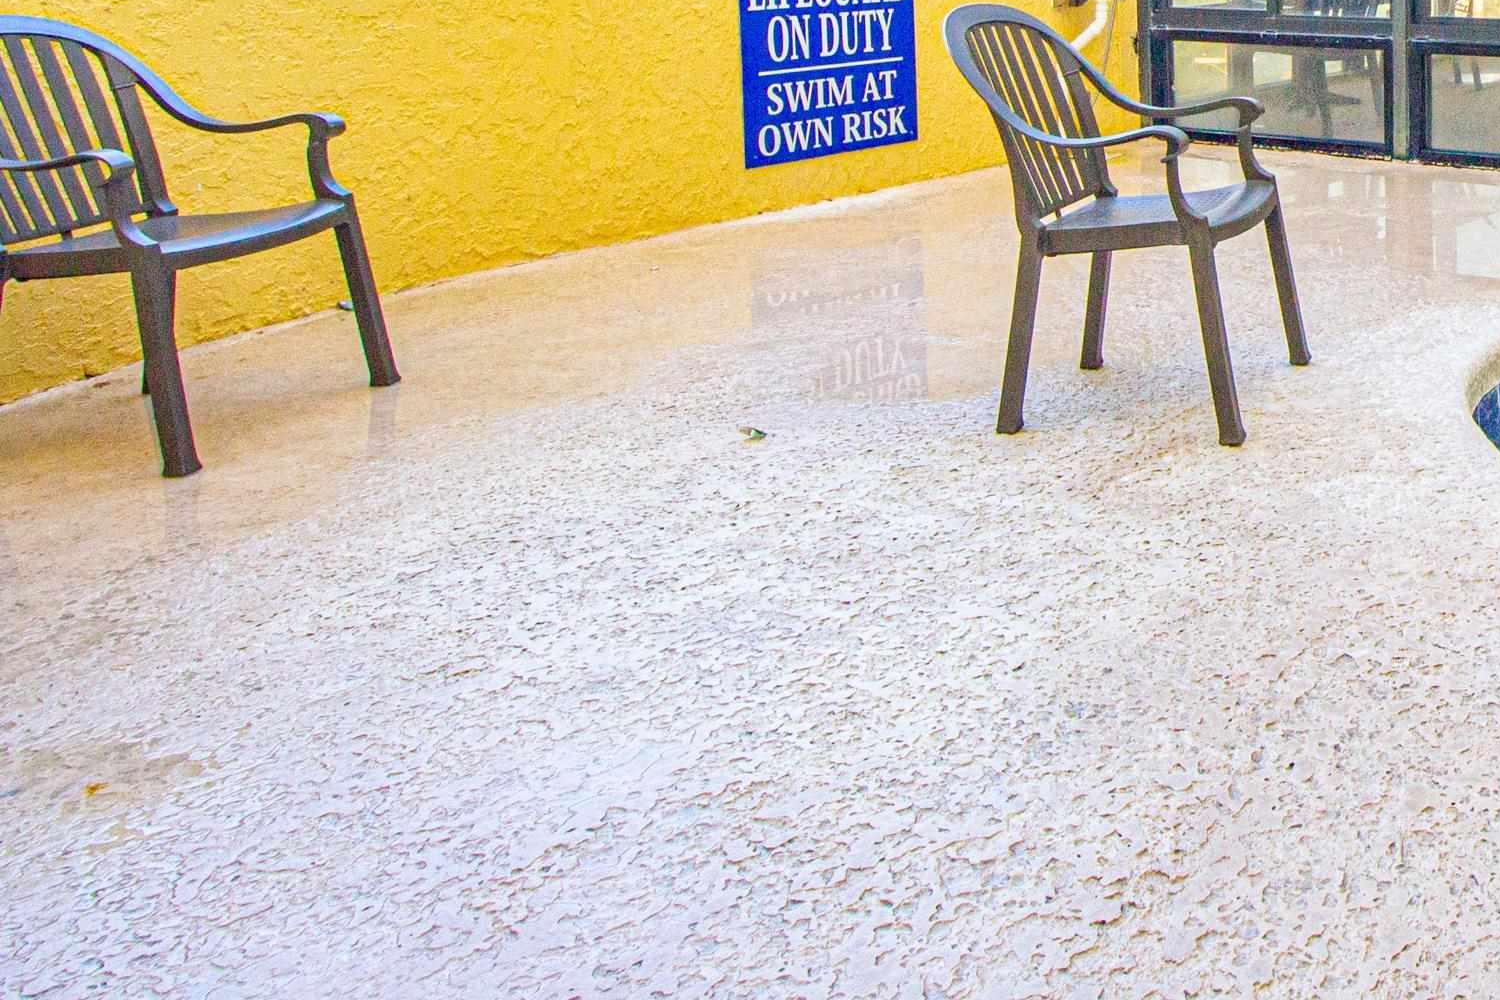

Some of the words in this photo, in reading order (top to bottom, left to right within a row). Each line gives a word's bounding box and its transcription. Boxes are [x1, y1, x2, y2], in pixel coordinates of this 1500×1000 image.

[767, 14, 810, 62] ON
[819, 8, 894, 57] DUTY
[767, 75, 854, 116] SWIM
[862, 69, 897, 102] AT
[758, 116, 833, 157] OWN
[842, 106, 907, 144] RISK
